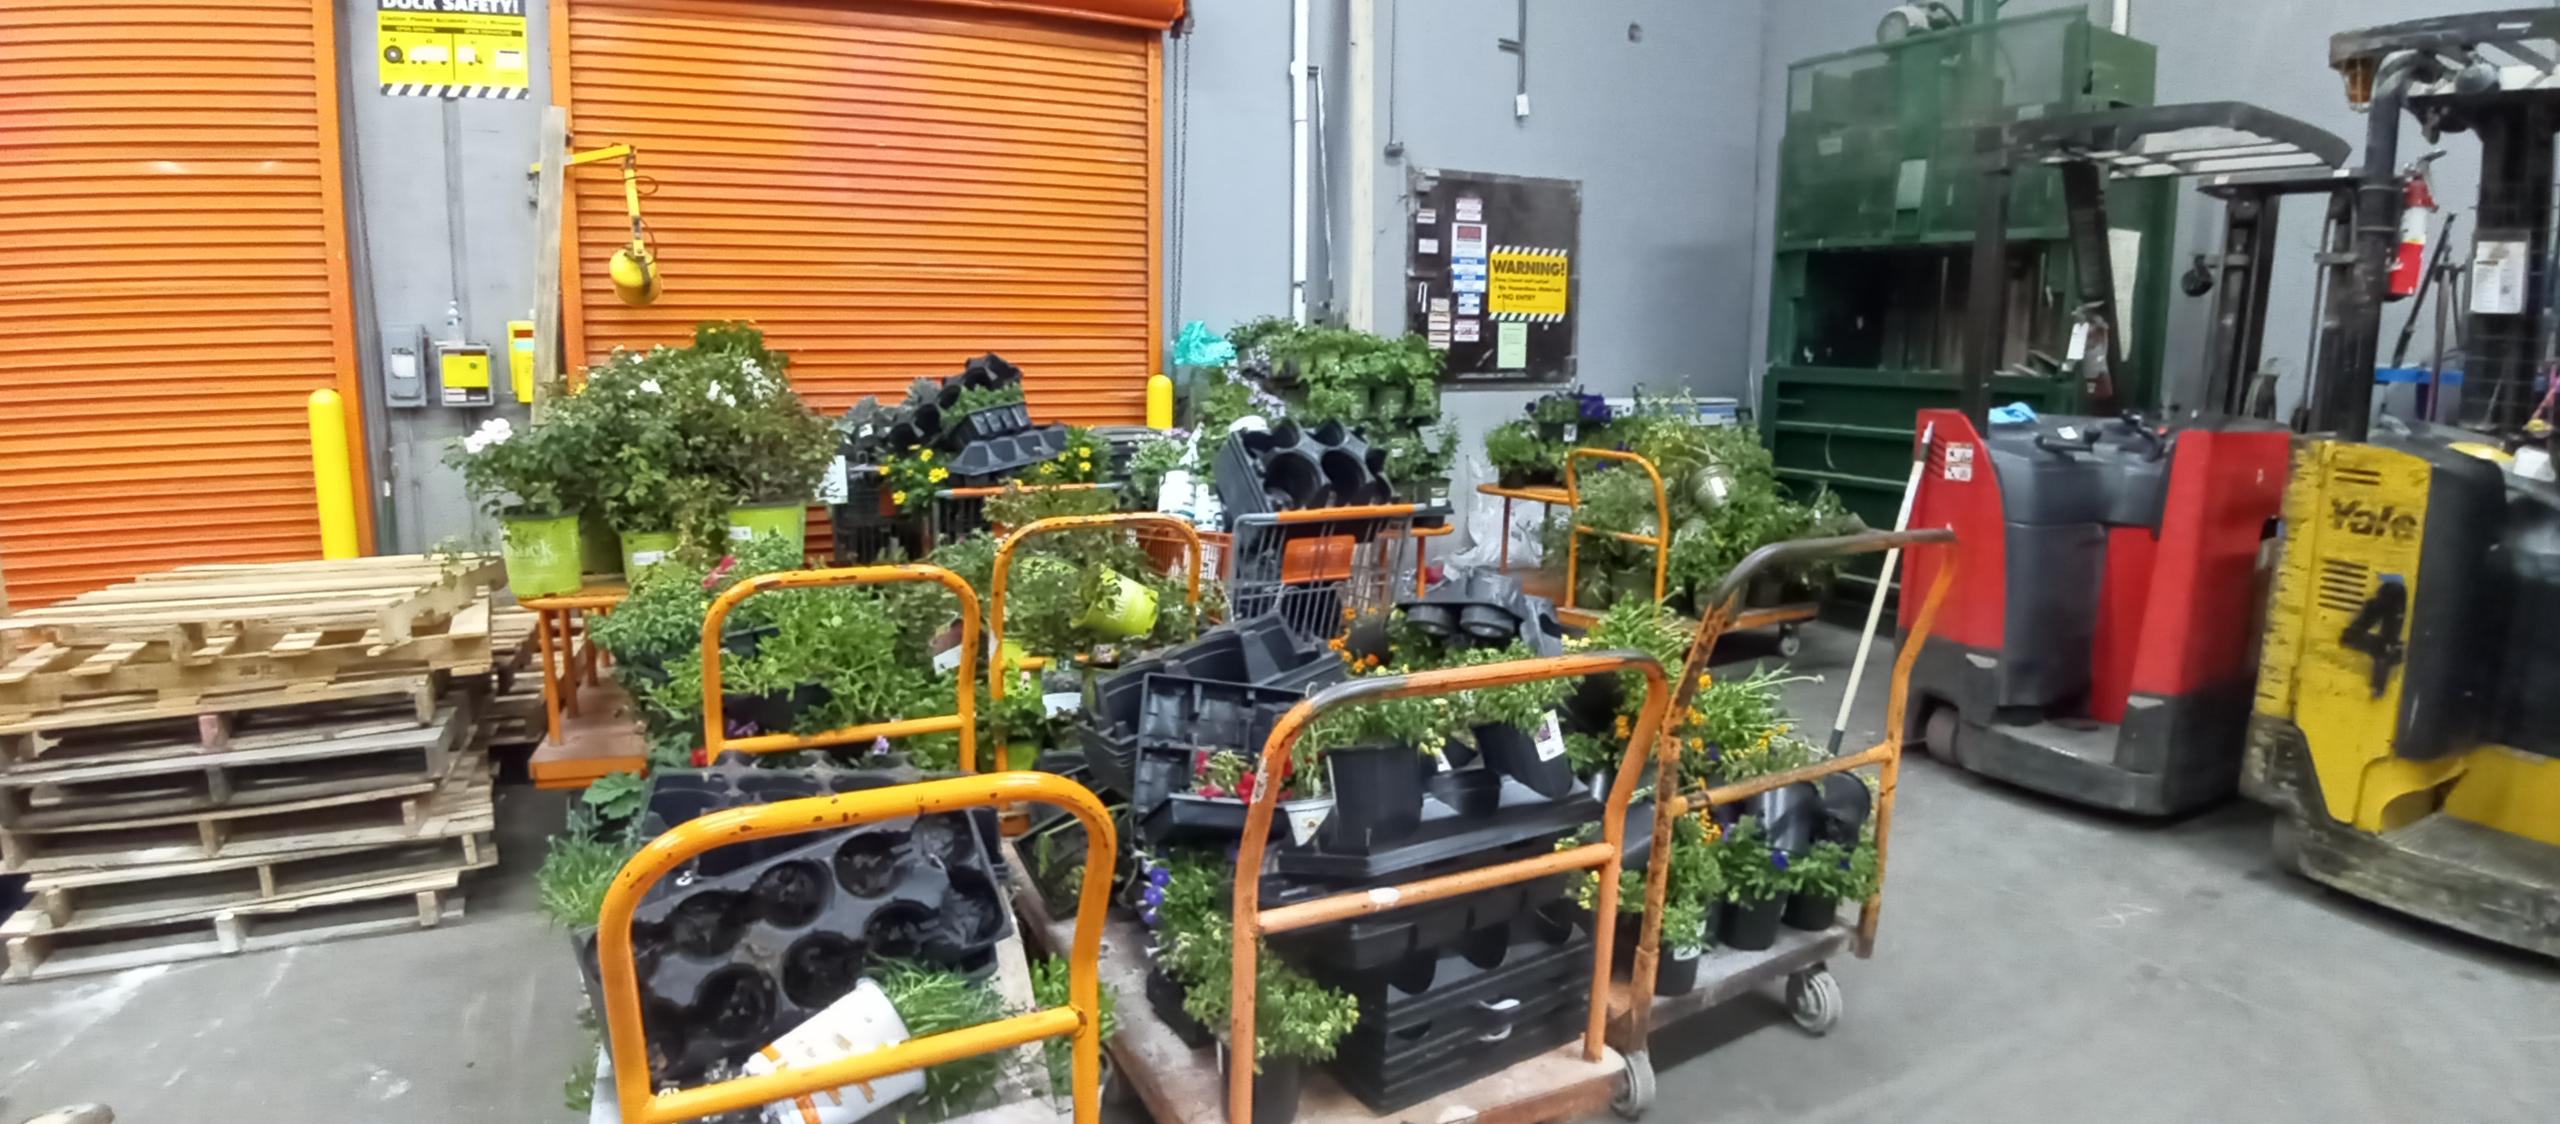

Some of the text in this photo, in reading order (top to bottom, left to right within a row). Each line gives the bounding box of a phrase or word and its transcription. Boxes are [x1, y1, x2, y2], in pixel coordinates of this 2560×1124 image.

[381, 0, 520, 14] DOCK SAFETY!
[1491, 259, 1566, 277] WARNING!
[2330, 498, 2418, 540] Yale
[2342, 578, 2407, 698] 4
